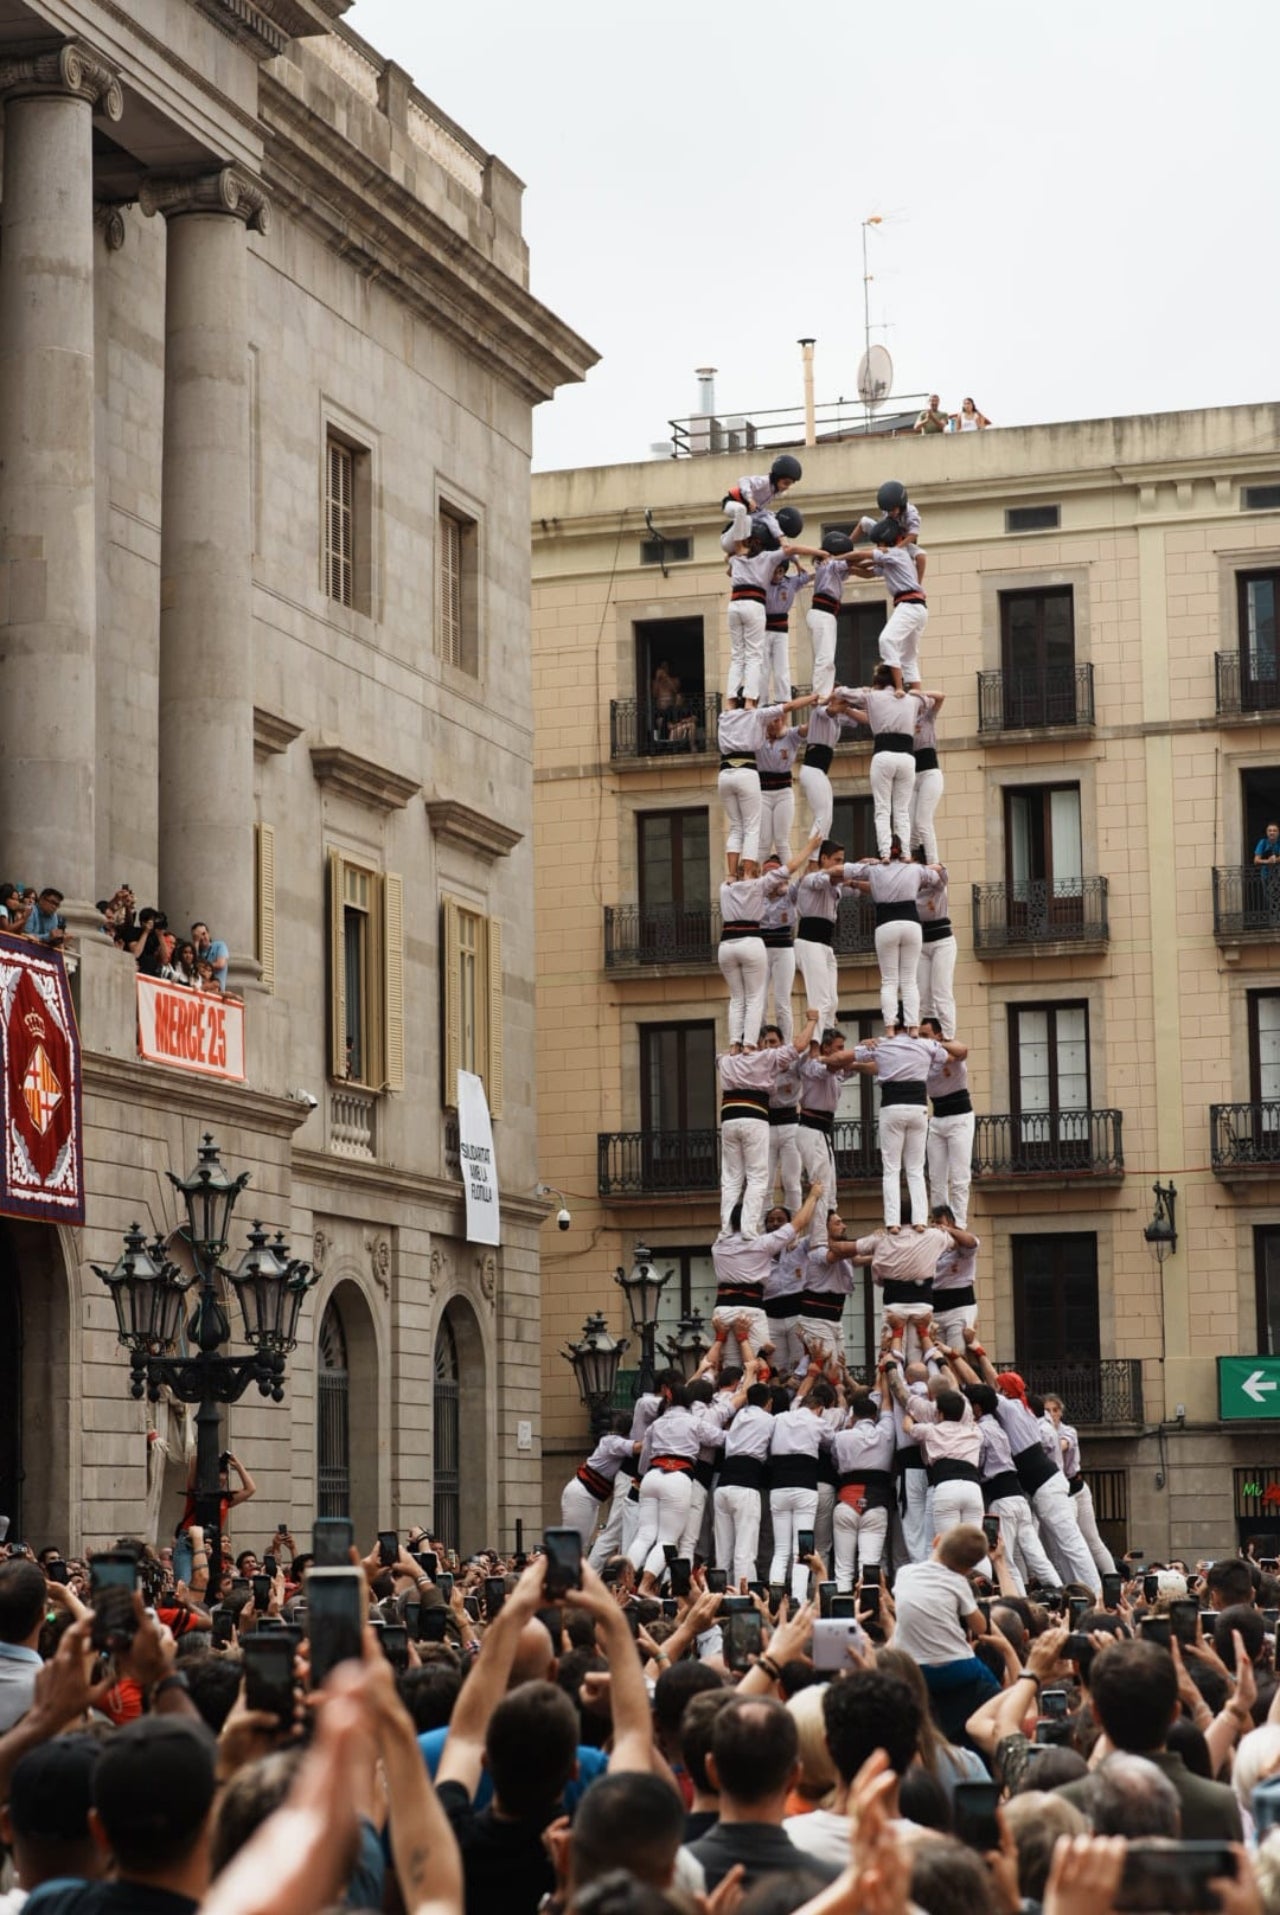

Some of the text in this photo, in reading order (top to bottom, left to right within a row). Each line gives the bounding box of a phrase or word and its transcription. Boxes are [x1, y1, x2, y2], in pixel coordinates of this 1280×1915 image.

[155, 992, 226, 1068] MERCÈ 25
[1243, 1482, 1263, 1497] Mi
